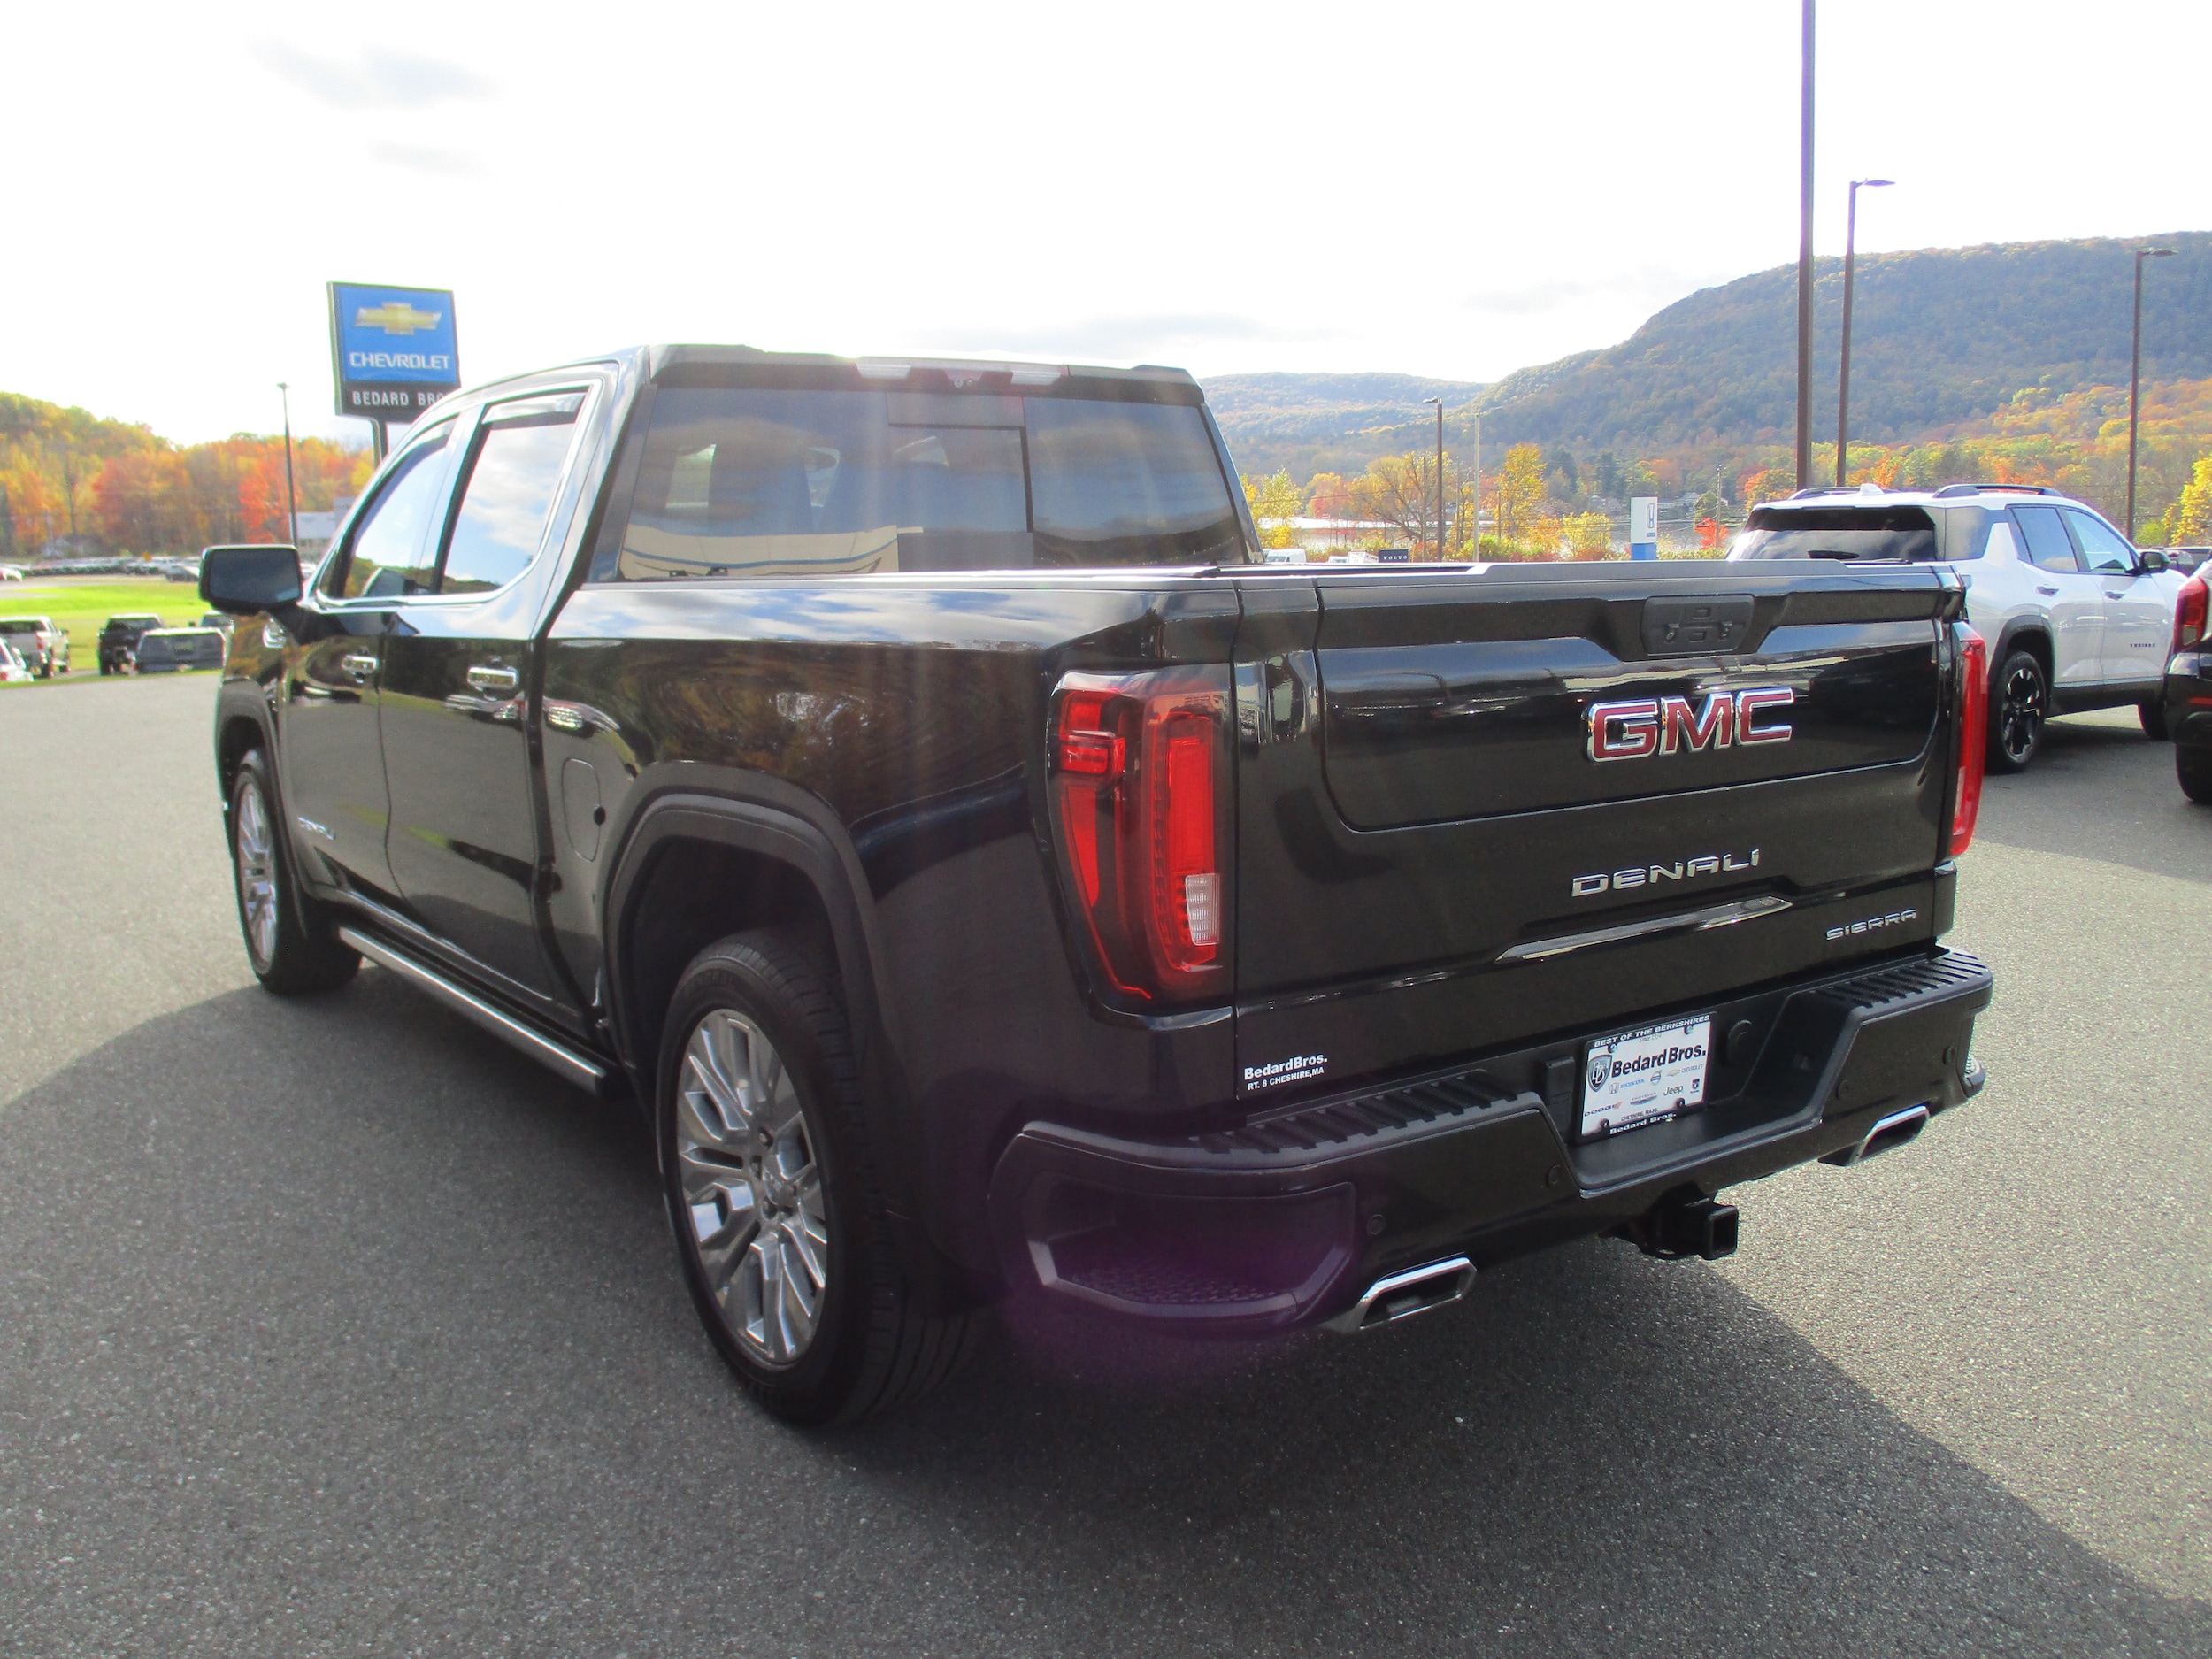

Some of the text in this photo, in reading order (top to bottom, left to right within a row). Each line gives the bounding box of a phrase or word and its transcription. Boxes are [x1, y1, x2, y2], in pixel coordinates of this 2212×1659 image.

[349, 352, 449, 370] CHEVROLET
[352, 391, 409, 406] BEDARD
[1586, 687, 1795, 762] GMC
[1571, 848, 1760, 897] DENALI
[1825, 908, 1917, 941] SIERRA
[1594, 1015, 1710, 1048] BEST OF THE BERKSHIRES
[1247, 1082, 1261, 1091] RT.
[1620, 1079, 1645, 1088] HONDA
[1663, 1085, 1684, 1096] Jeep
[1585, 1103, 1617, 1117] DODGE
[1609, 1112, 1677, 1135] Bedard Bros.
